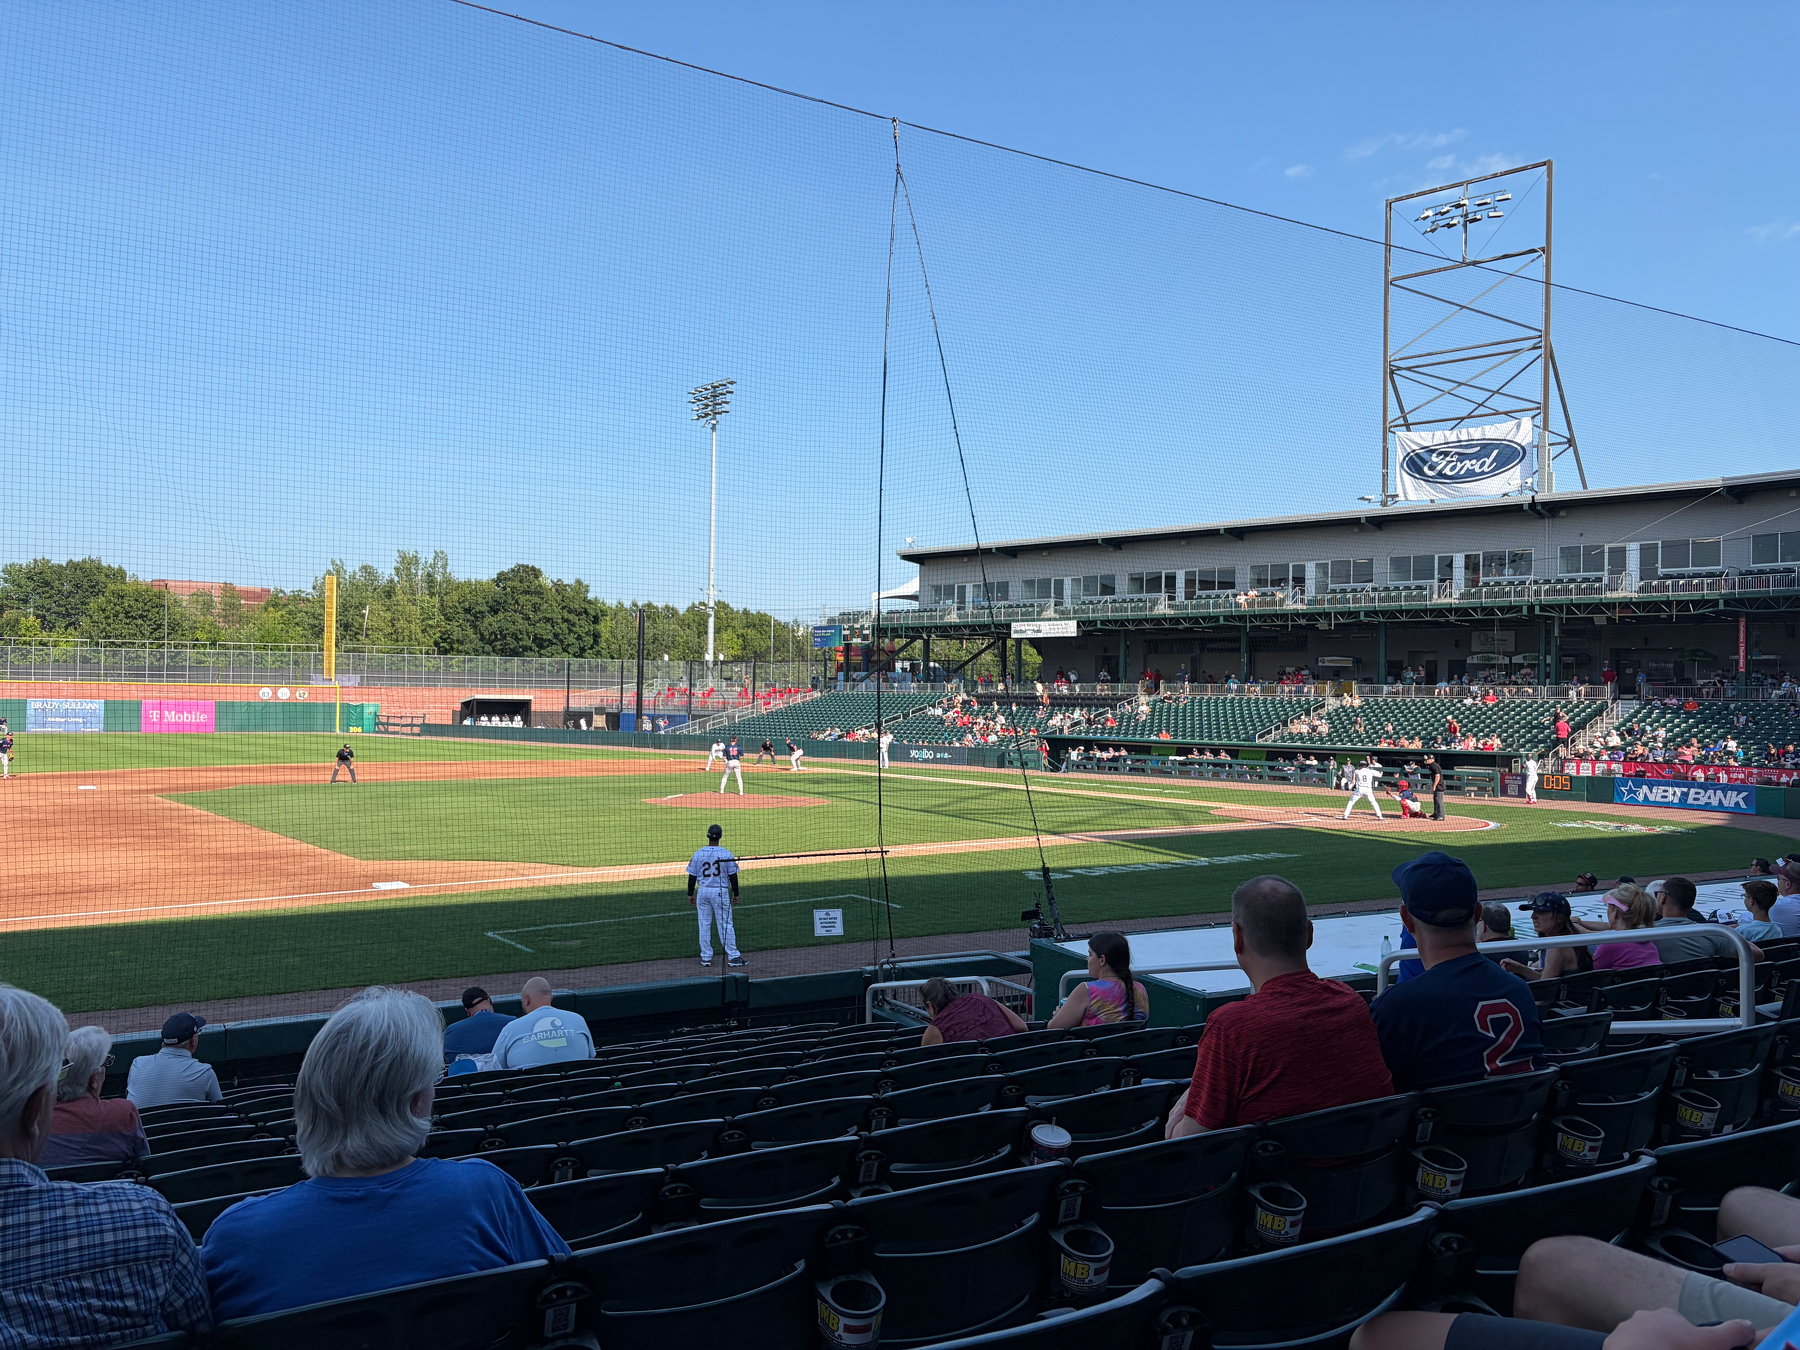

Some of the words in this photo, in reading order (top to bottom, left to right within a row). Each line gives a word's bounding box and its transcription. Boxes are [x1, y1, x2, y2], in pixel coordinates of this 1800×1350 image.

[1423, 446, 1499, 476] Ford
[1649, 661, 1674, 669] Heritag
[31, 701, 60, 709] BRADY
[62, 701, 99, 710] SULLIVAN
[164, 710, 208, 722] Mobile
[910, 748, 934, 761] yogibo
[1361, 774, 1367, 782] 8
[1543, 774, 1571, 790] 0:05
[1639, 785, 1688, 804] NBT
[1687, 787, 1749, 808] BANK
[702, 861, 721, 878] 23
[522, 1029, 575, 1044] CARHARTT
[1473, 998, 1535, 1080] 2
[1680, 1106, 1703, 1123] MB
[1561, 1134, 1586, 1153] MB
[1422, 1168, 1447, 1189] MB
[1260, 1210, 1286, 1231] MB
[1062, 1257, 1090, 1279] MB
[820, 1303, 840, 1332] MB
